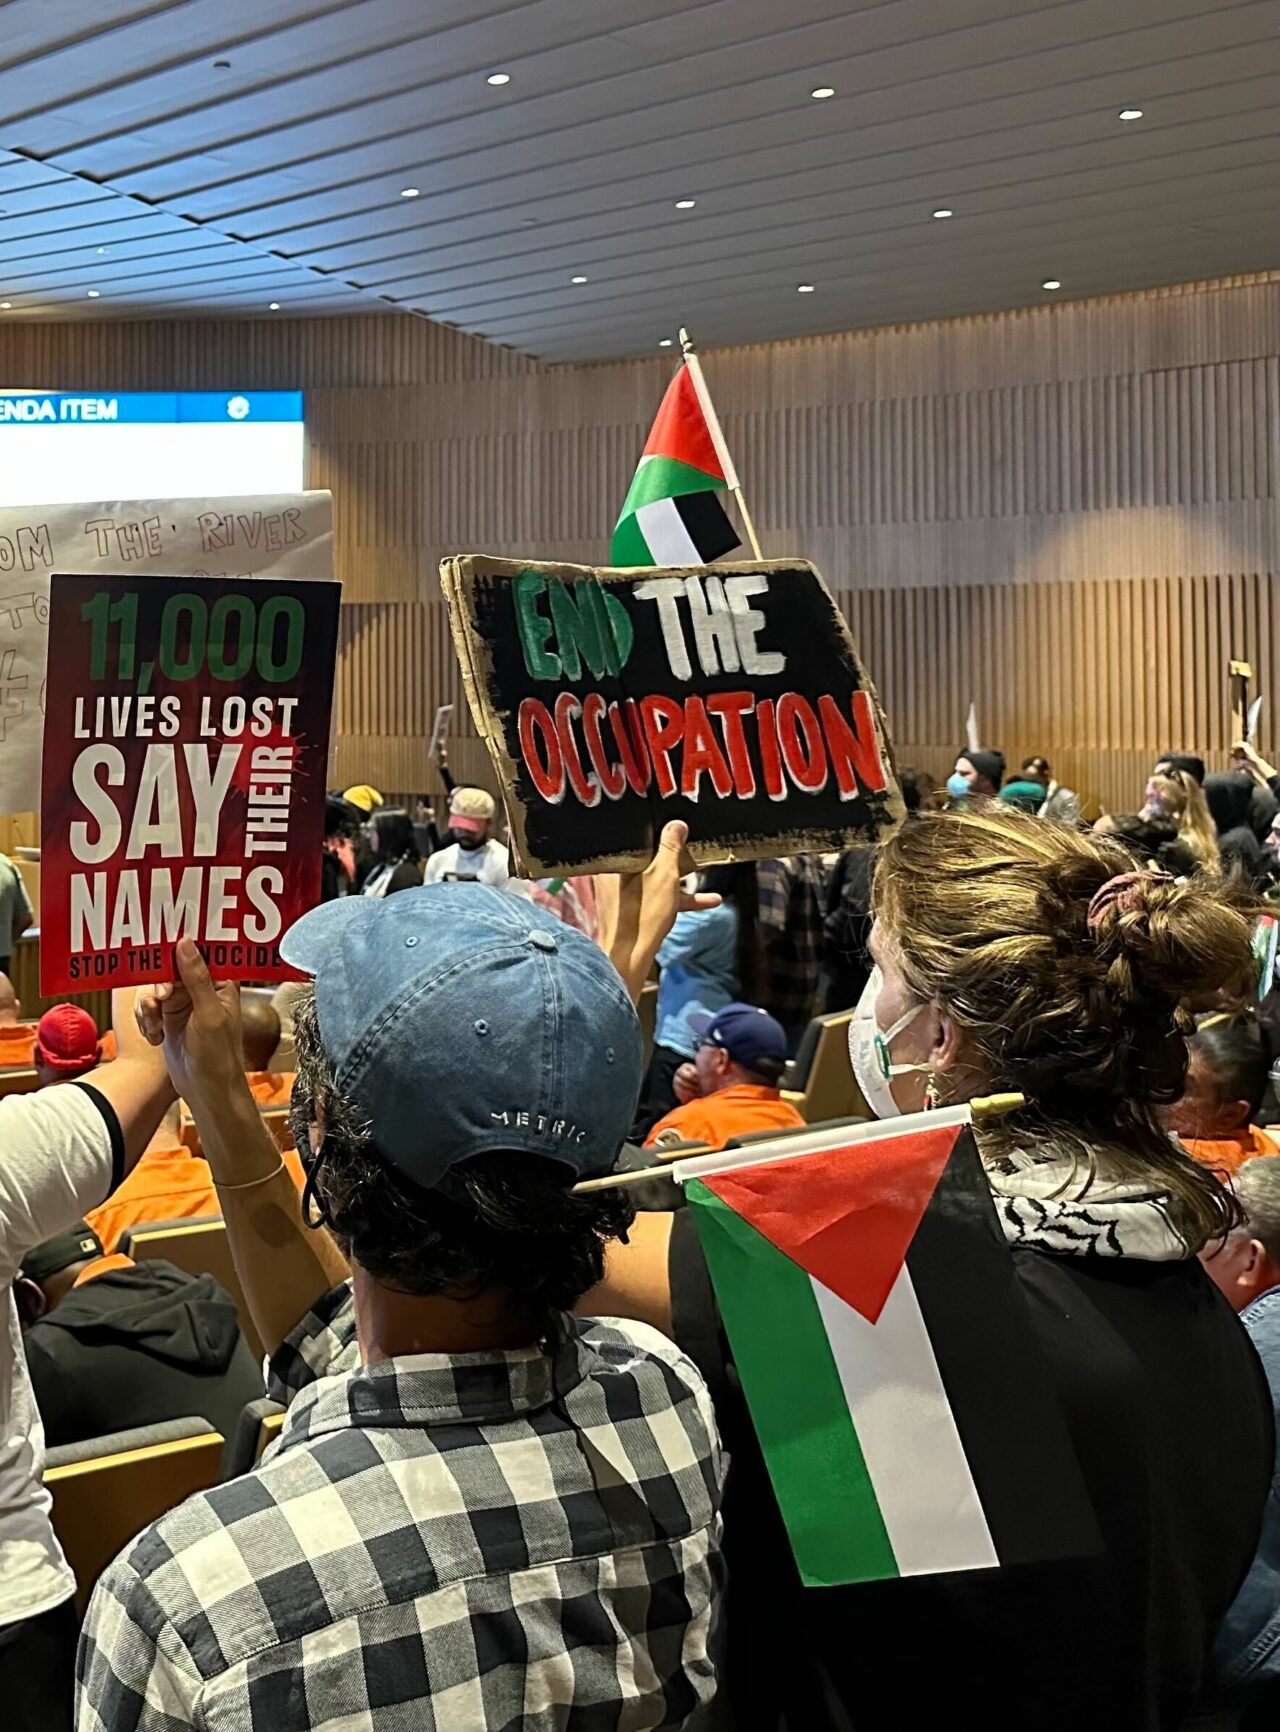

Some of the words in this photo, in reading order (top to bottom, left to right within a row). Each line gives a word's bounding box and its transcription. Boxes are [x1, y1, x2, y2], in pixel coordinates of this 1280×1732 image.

[60, 399, 118, 421] ITEM
[85, 516, 163, 561] THE
[197, 507, 308, 552] RIVER
[80, 592, 306, 695] 11,000
[511, 570, 634, 682] END
[632, 575, 787, 682] THE
[74, 696, 181, 739] LIVES
[200, 696, 299, 738] LOST
[517, 690, 887, 807] OCCUPATION
[69, 743, 244, 865] SAY
[244, 745, 294, 858] THEIR
[70, 865, 284, 953] NAMES
[70, 953, 119, 979] STOP
[128, 948, 162, 973] THE
[172, 944, 281, 969] NOCIDE
[490, 1111, 586, 1143] METRIC
